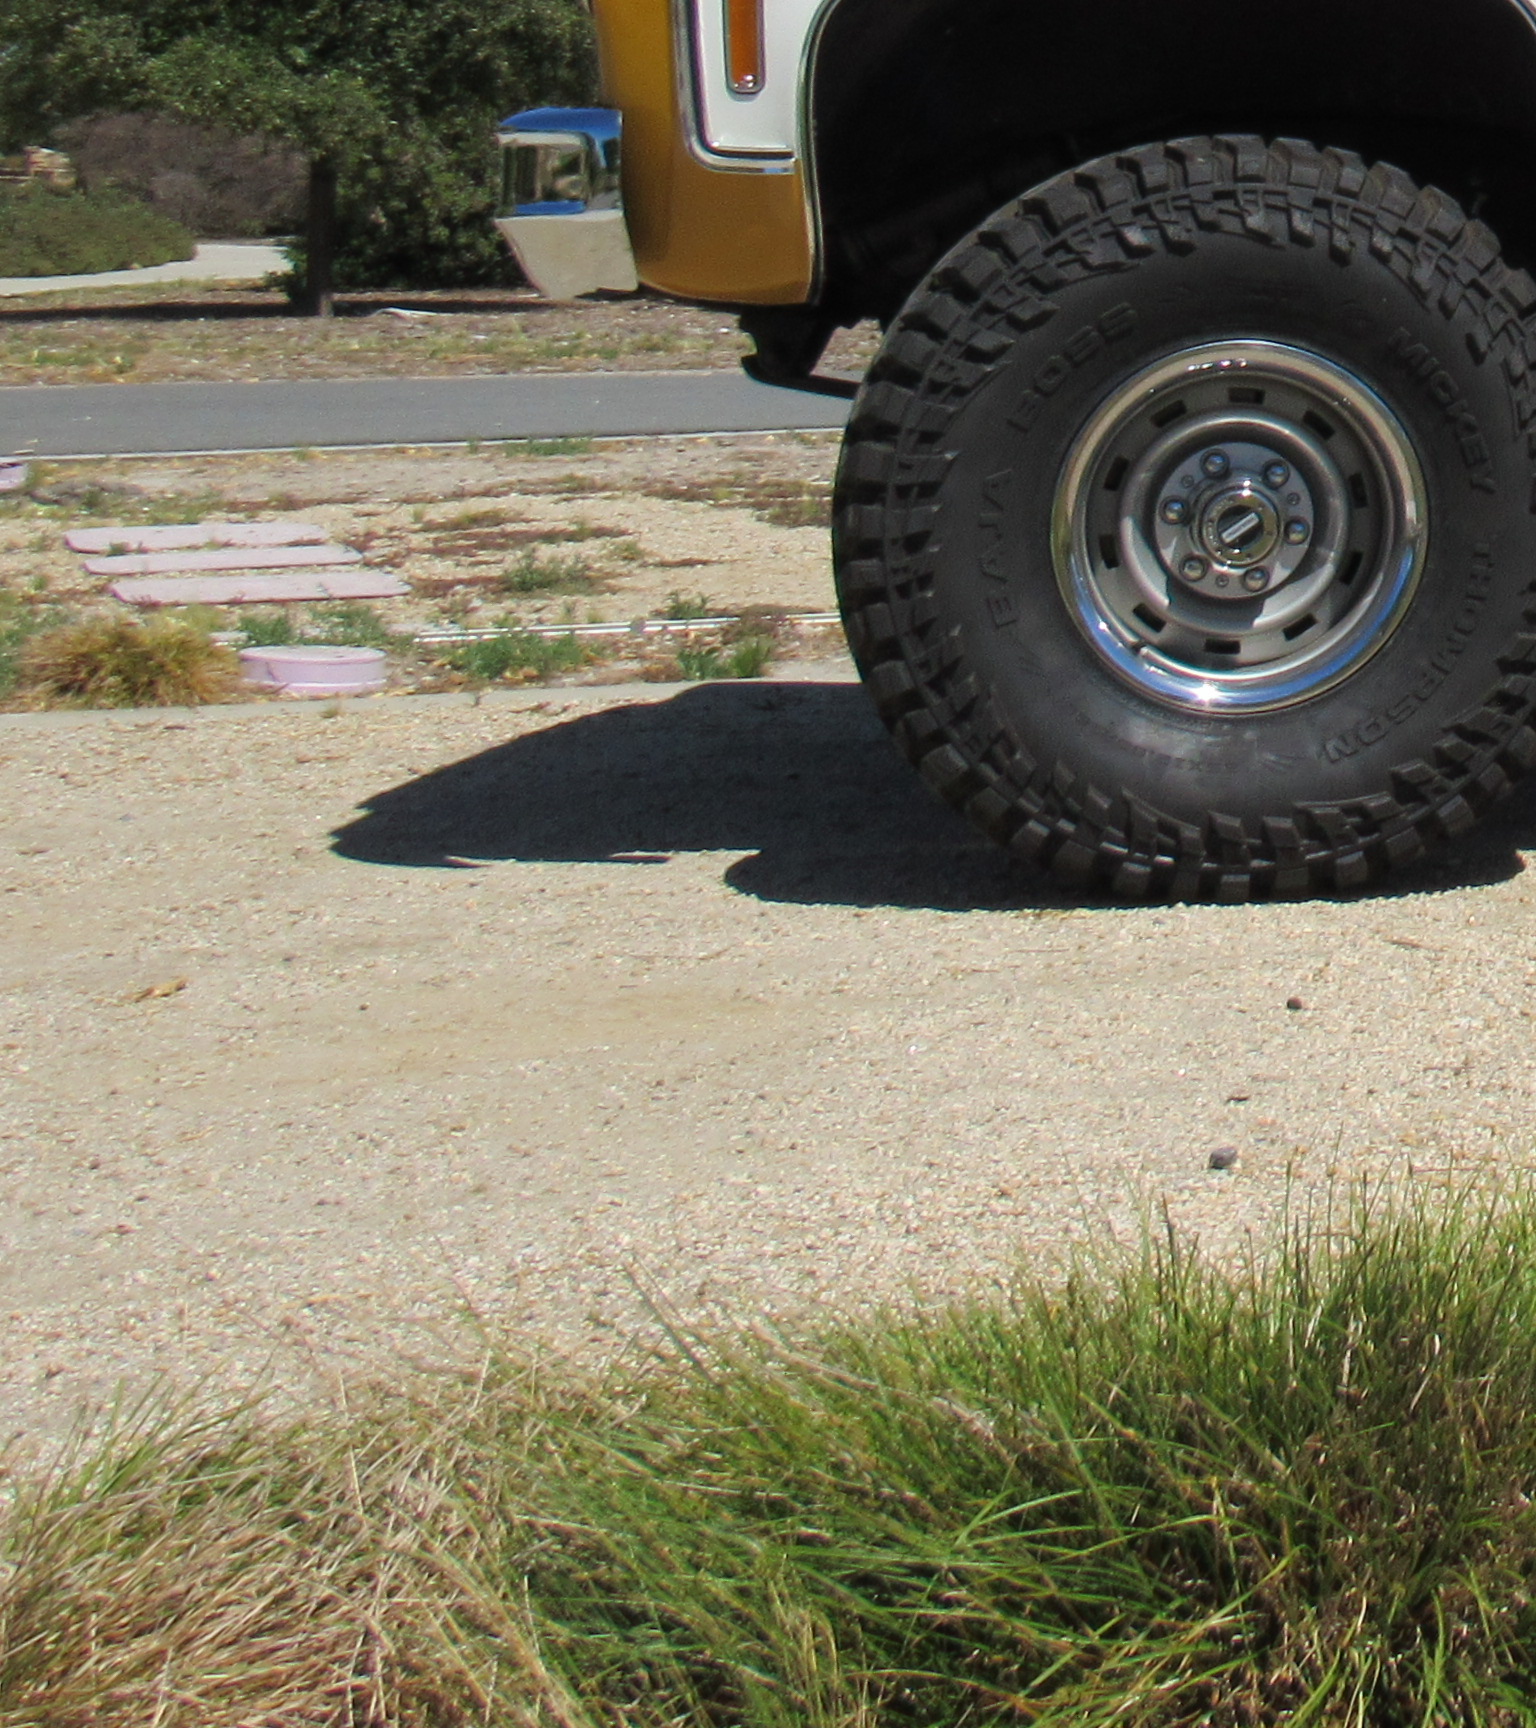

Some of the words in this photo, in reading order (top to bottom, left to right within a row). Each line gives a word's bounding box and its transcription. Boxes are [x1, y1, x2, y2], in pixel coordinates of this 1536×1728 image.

[978, 466, 1018, 628] BAJA
[1006, 301, 1138, 434] BOSS
[1387, 326, 1497, 495] MICKEY
[1320, 538, 1494, 764] THOMPSON
